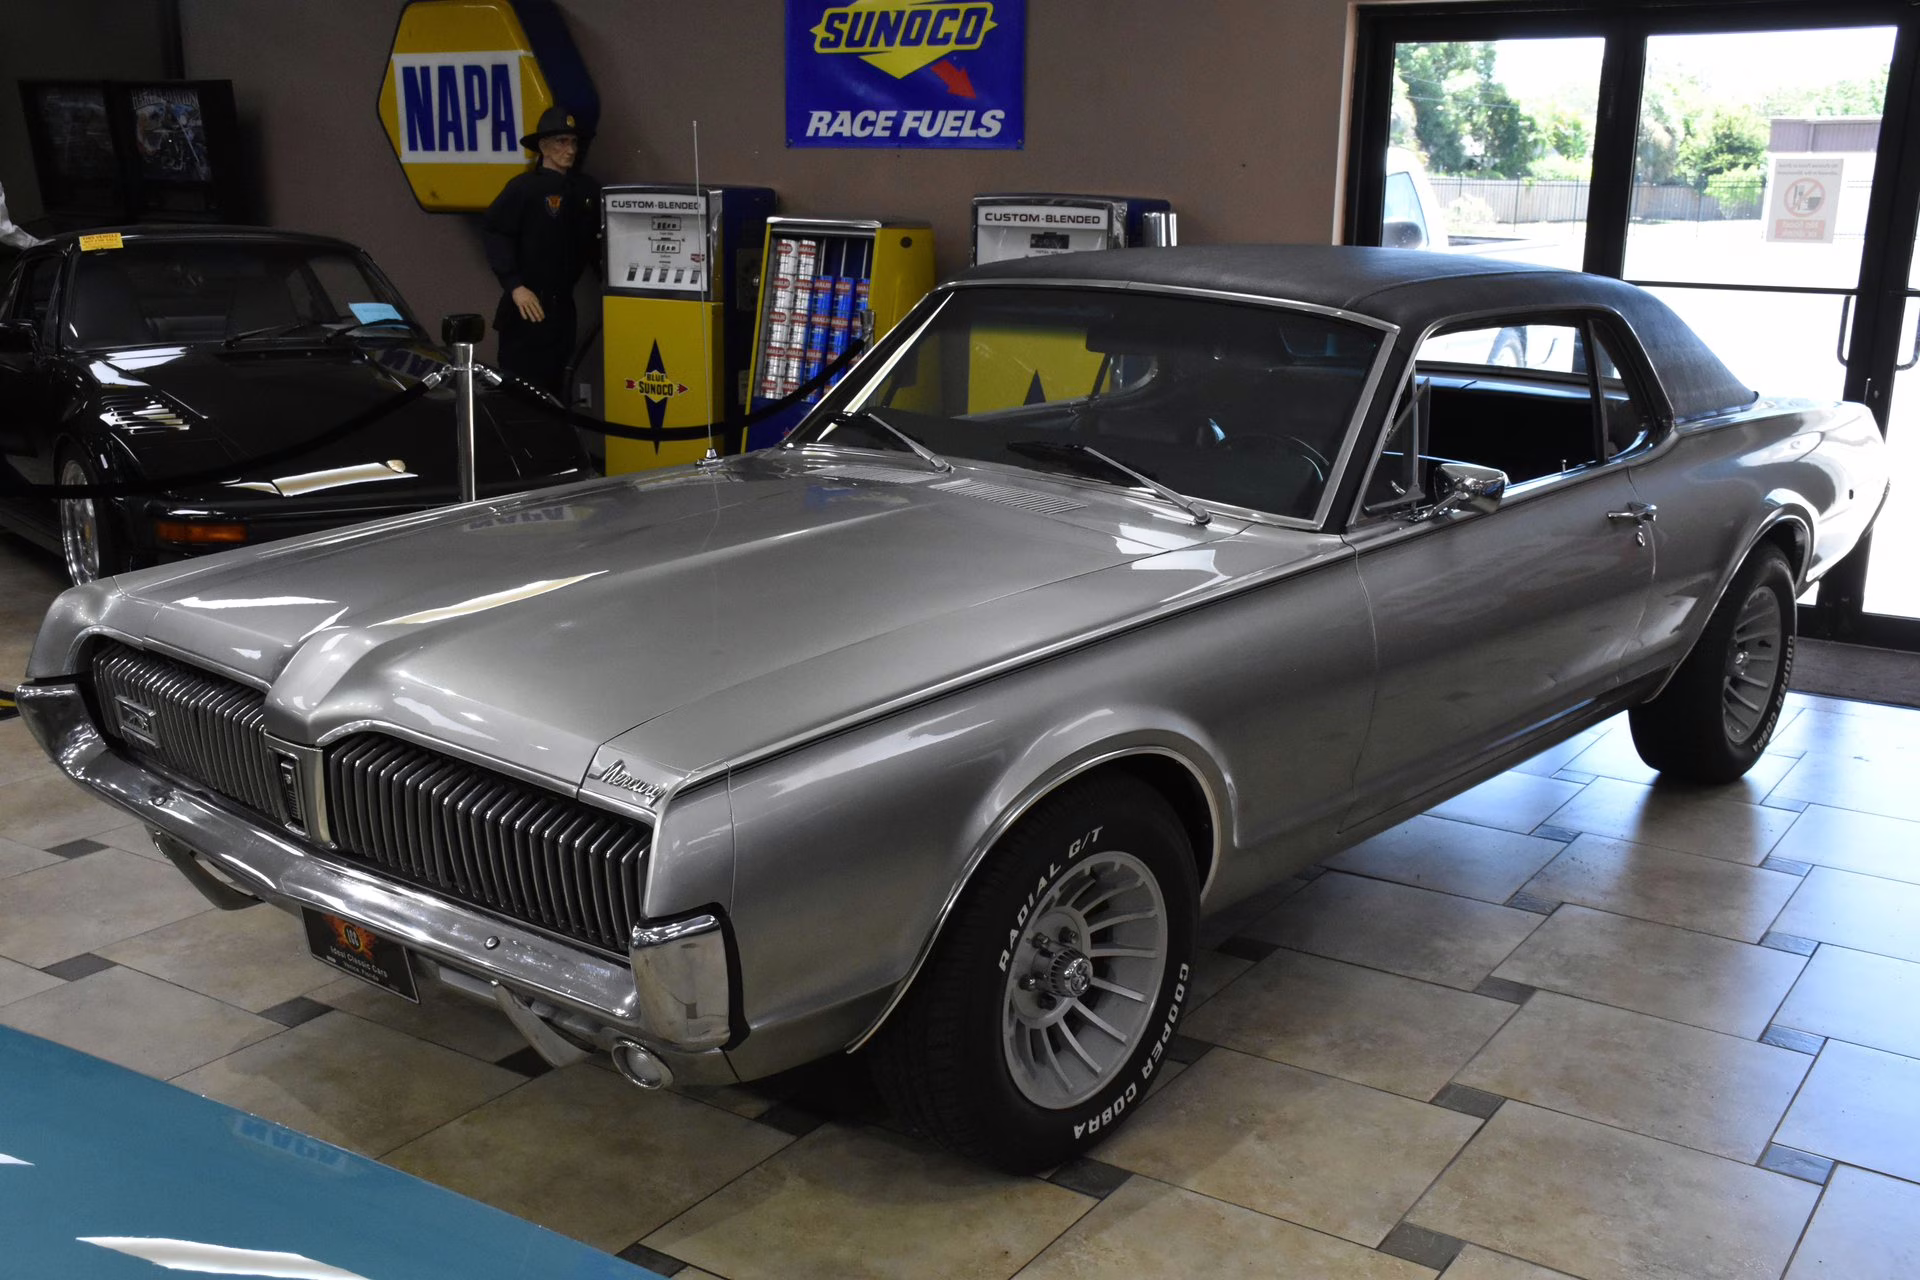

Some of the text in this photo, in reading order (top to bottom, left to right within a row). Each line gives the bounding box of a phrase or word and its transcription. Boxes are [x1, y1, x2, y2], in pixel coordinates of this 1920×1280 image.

[819, 7, 988, 49] SUNOCO
[402, 63, 518, 152] NAPA
[805, 109, 1006, 138] RACE FUELS
[638, 380, 674, 397] SUNOCO
[646, 373, 664, 383] BLUE
[587, 758, 669, 808] Mercury
[998, 826, 1104, 973] RADIAL G/T
[1073, 962, 1190, 1141] COOPER COBRA
